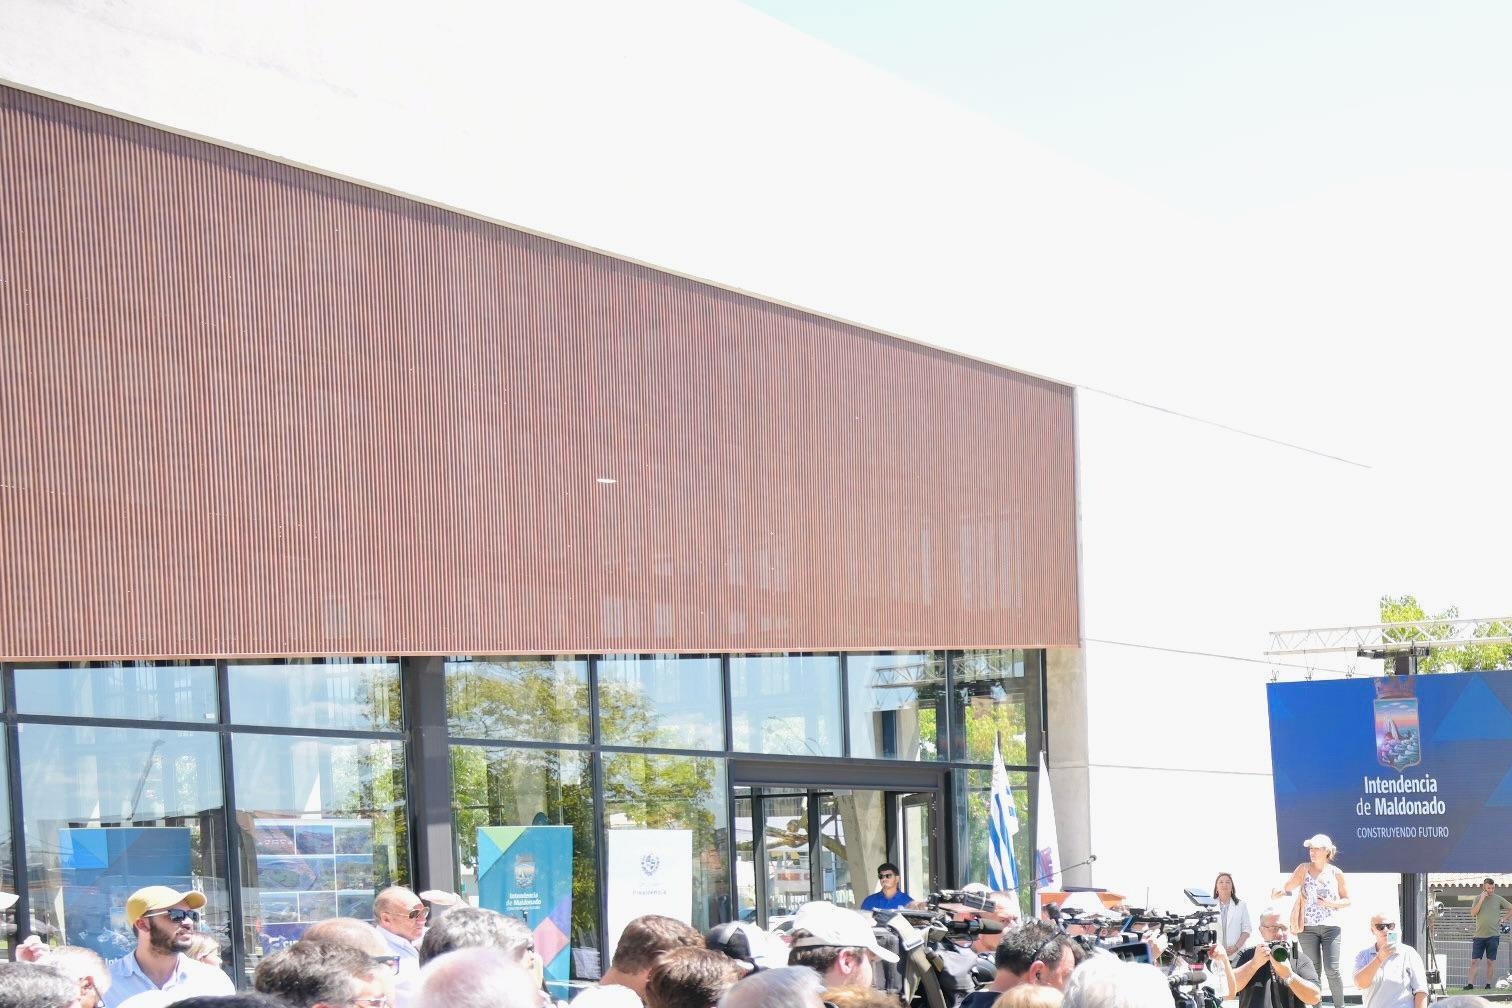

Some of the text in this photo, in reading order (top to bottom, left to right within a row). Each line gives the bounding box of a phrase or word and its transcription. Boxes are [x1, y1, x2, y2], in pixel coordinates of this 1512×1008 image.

[1364, 773, 1438, 794] Intendencia
[1356, 795, 1446, 816] de Maldonado
[1357, 826, 1449, 838] CONSTRUYENDO FUTURO
